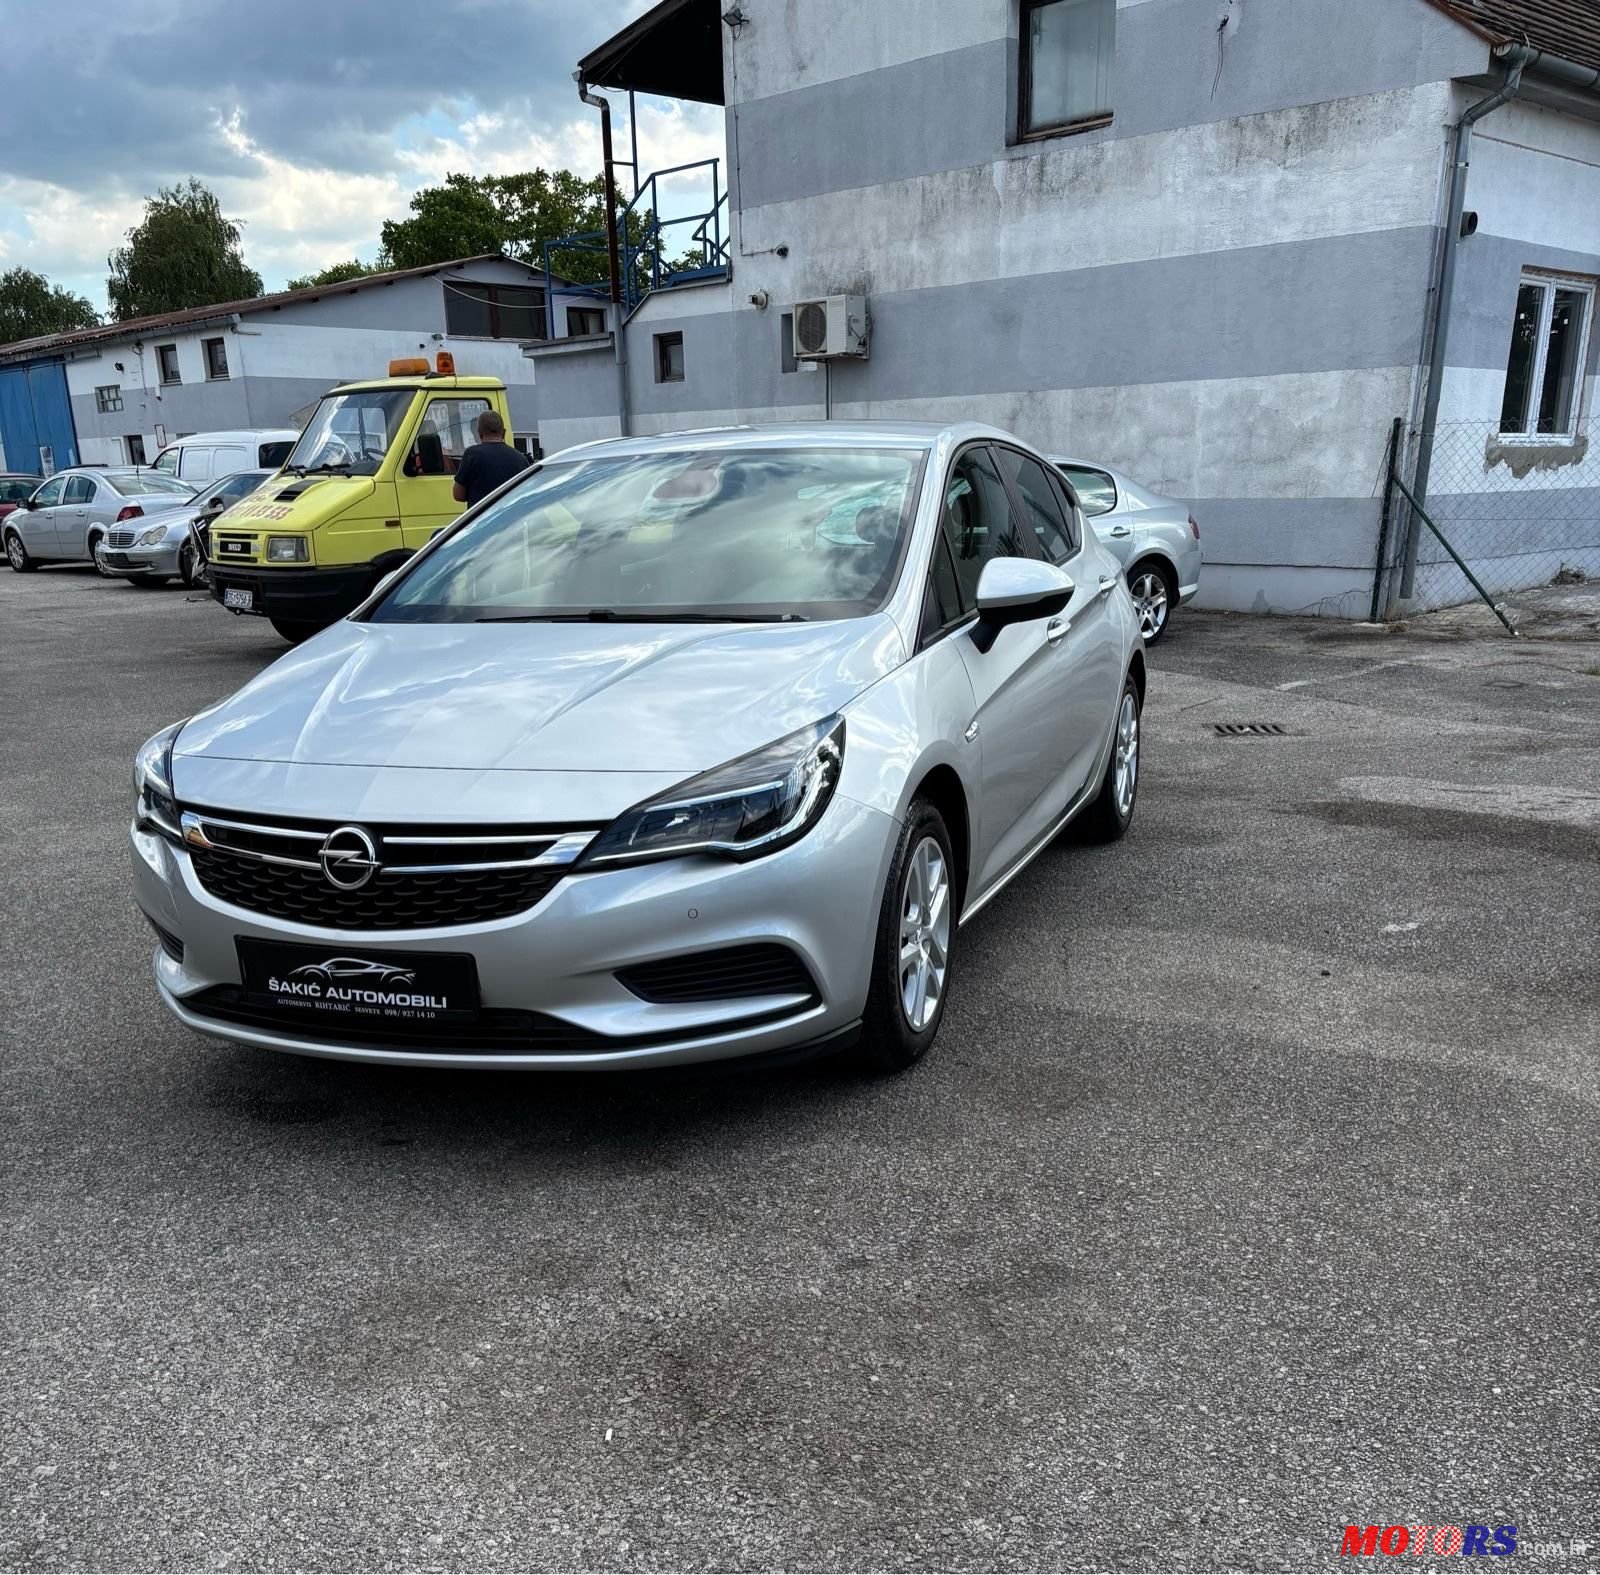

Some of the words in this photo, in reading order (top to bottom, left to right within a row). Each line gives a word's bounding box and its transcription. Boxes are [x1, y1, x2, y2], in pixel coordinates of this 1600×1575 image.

[228, 543, 242, 551] IVECO
[268, 976, 321, 996] ŠAKIĆ
[326, 986, 447, 1009] AUTOMOBILI
[426, 1011, 436, 1019] 10
